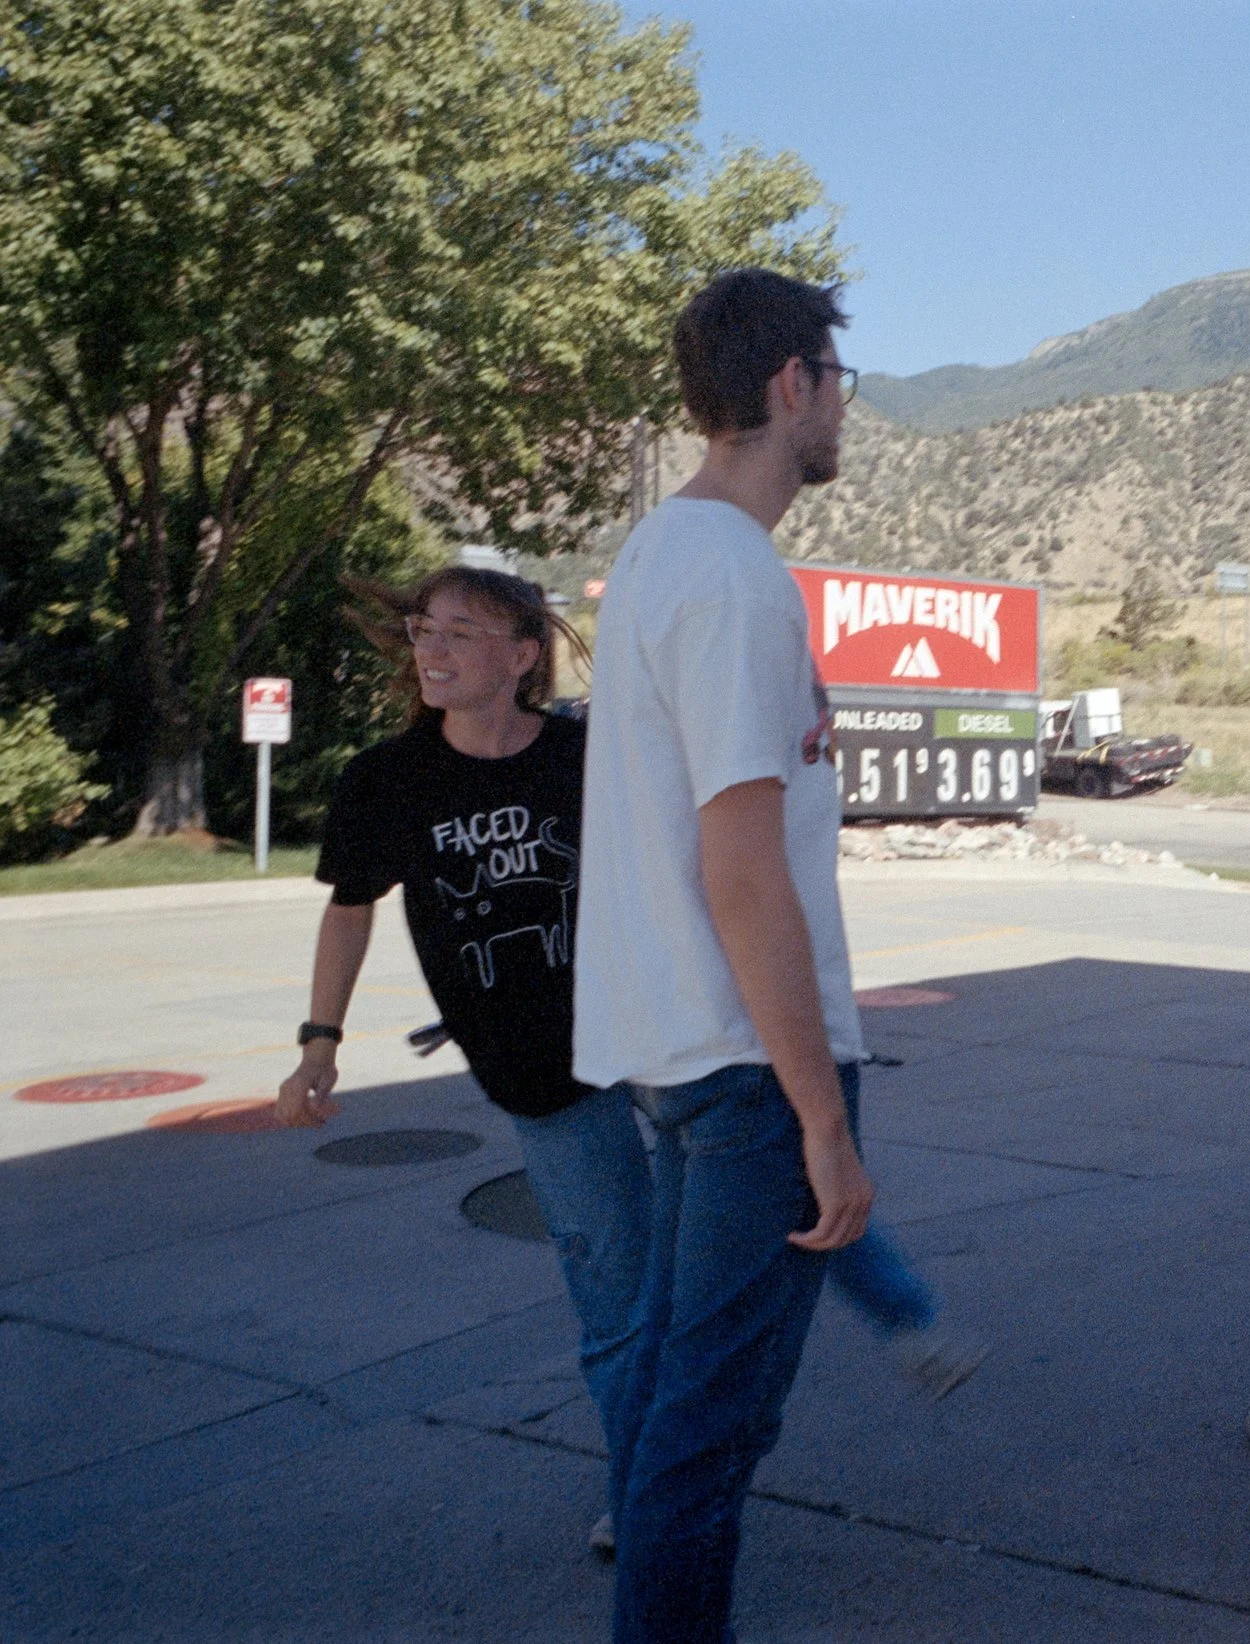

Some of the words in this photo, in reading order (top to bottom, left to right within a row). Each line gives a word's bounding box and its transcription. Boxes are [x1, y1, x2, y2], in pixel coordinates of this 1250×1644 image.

[823, 578, 1003, 665] MAVERIK
[957, 714, 1015, 734] DIESEL
[431, 805, 530, 857] FACED
[489, 838, 542, 881] OUT
